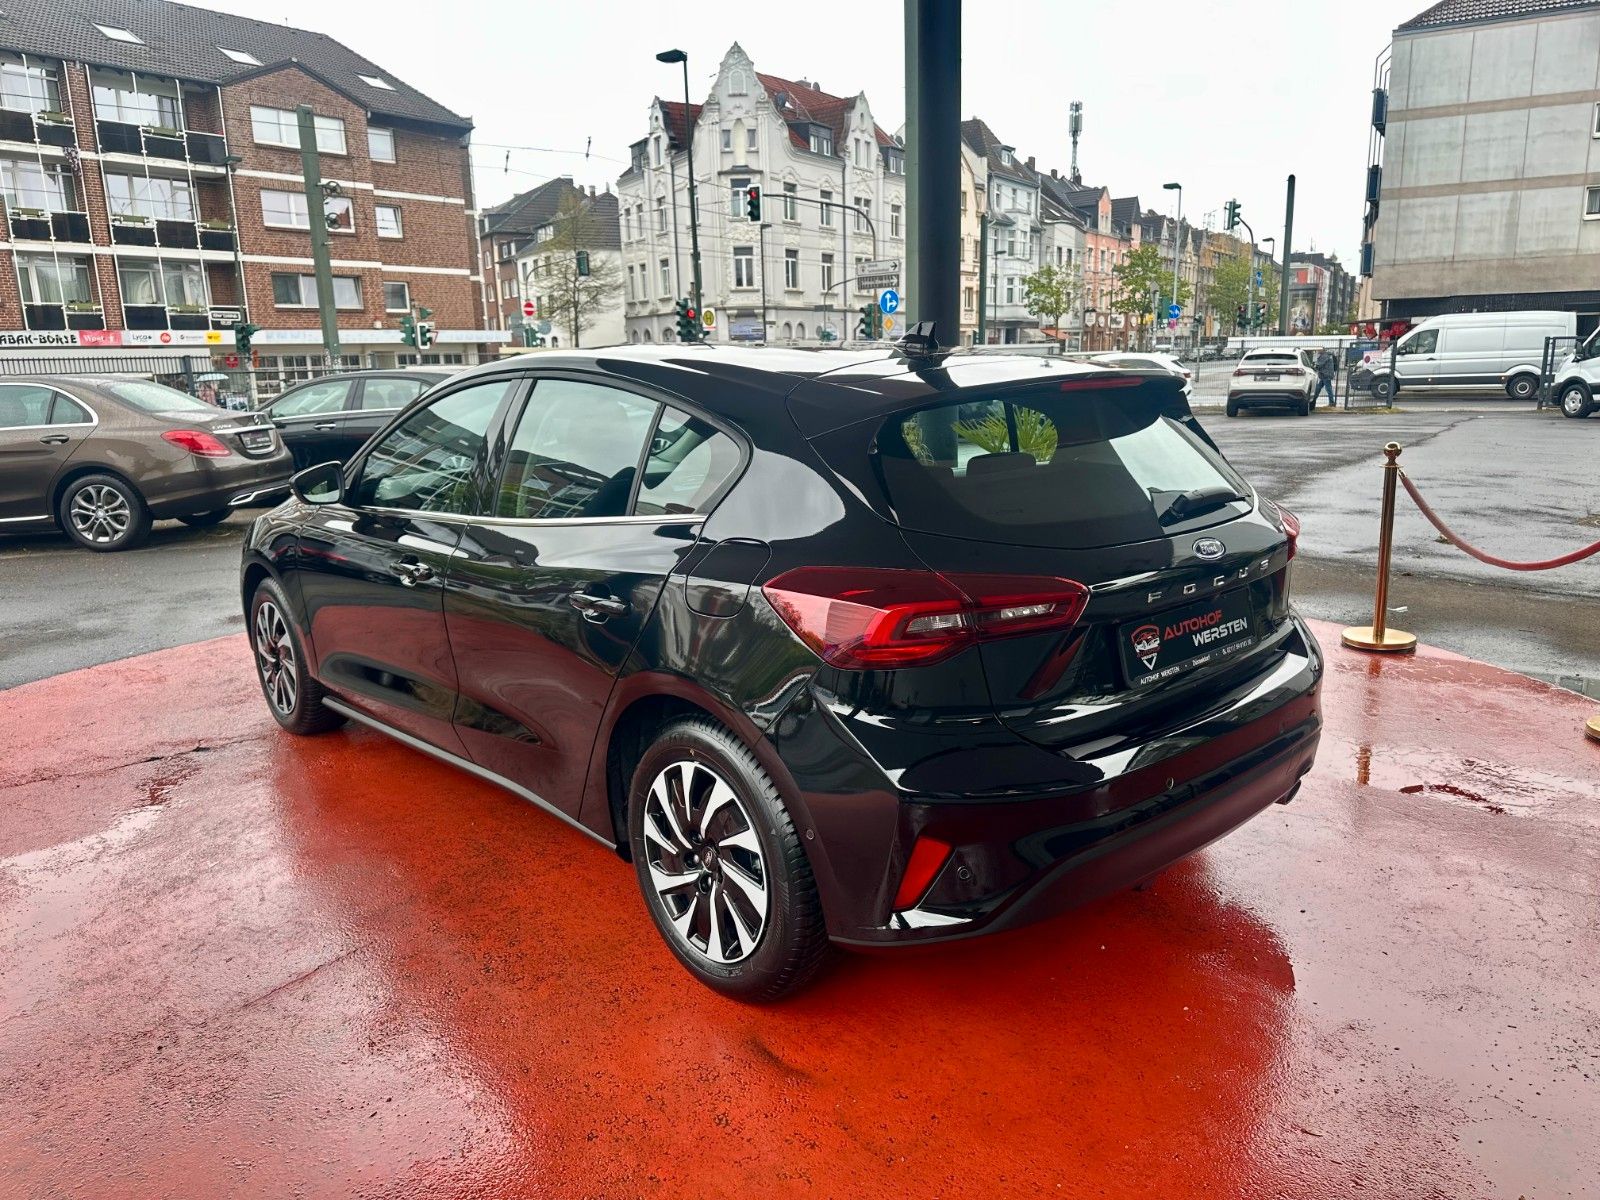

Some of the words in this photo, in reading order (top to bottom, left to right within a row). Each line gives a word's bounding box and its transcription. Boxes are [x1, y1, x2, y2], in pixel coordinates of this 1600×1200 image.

[1147, 559, 1269, 603] FOCUS
[1163, 609, 1223, 641] AUTOHOF
[1192, 617, 1248, 647] WERSTEN
